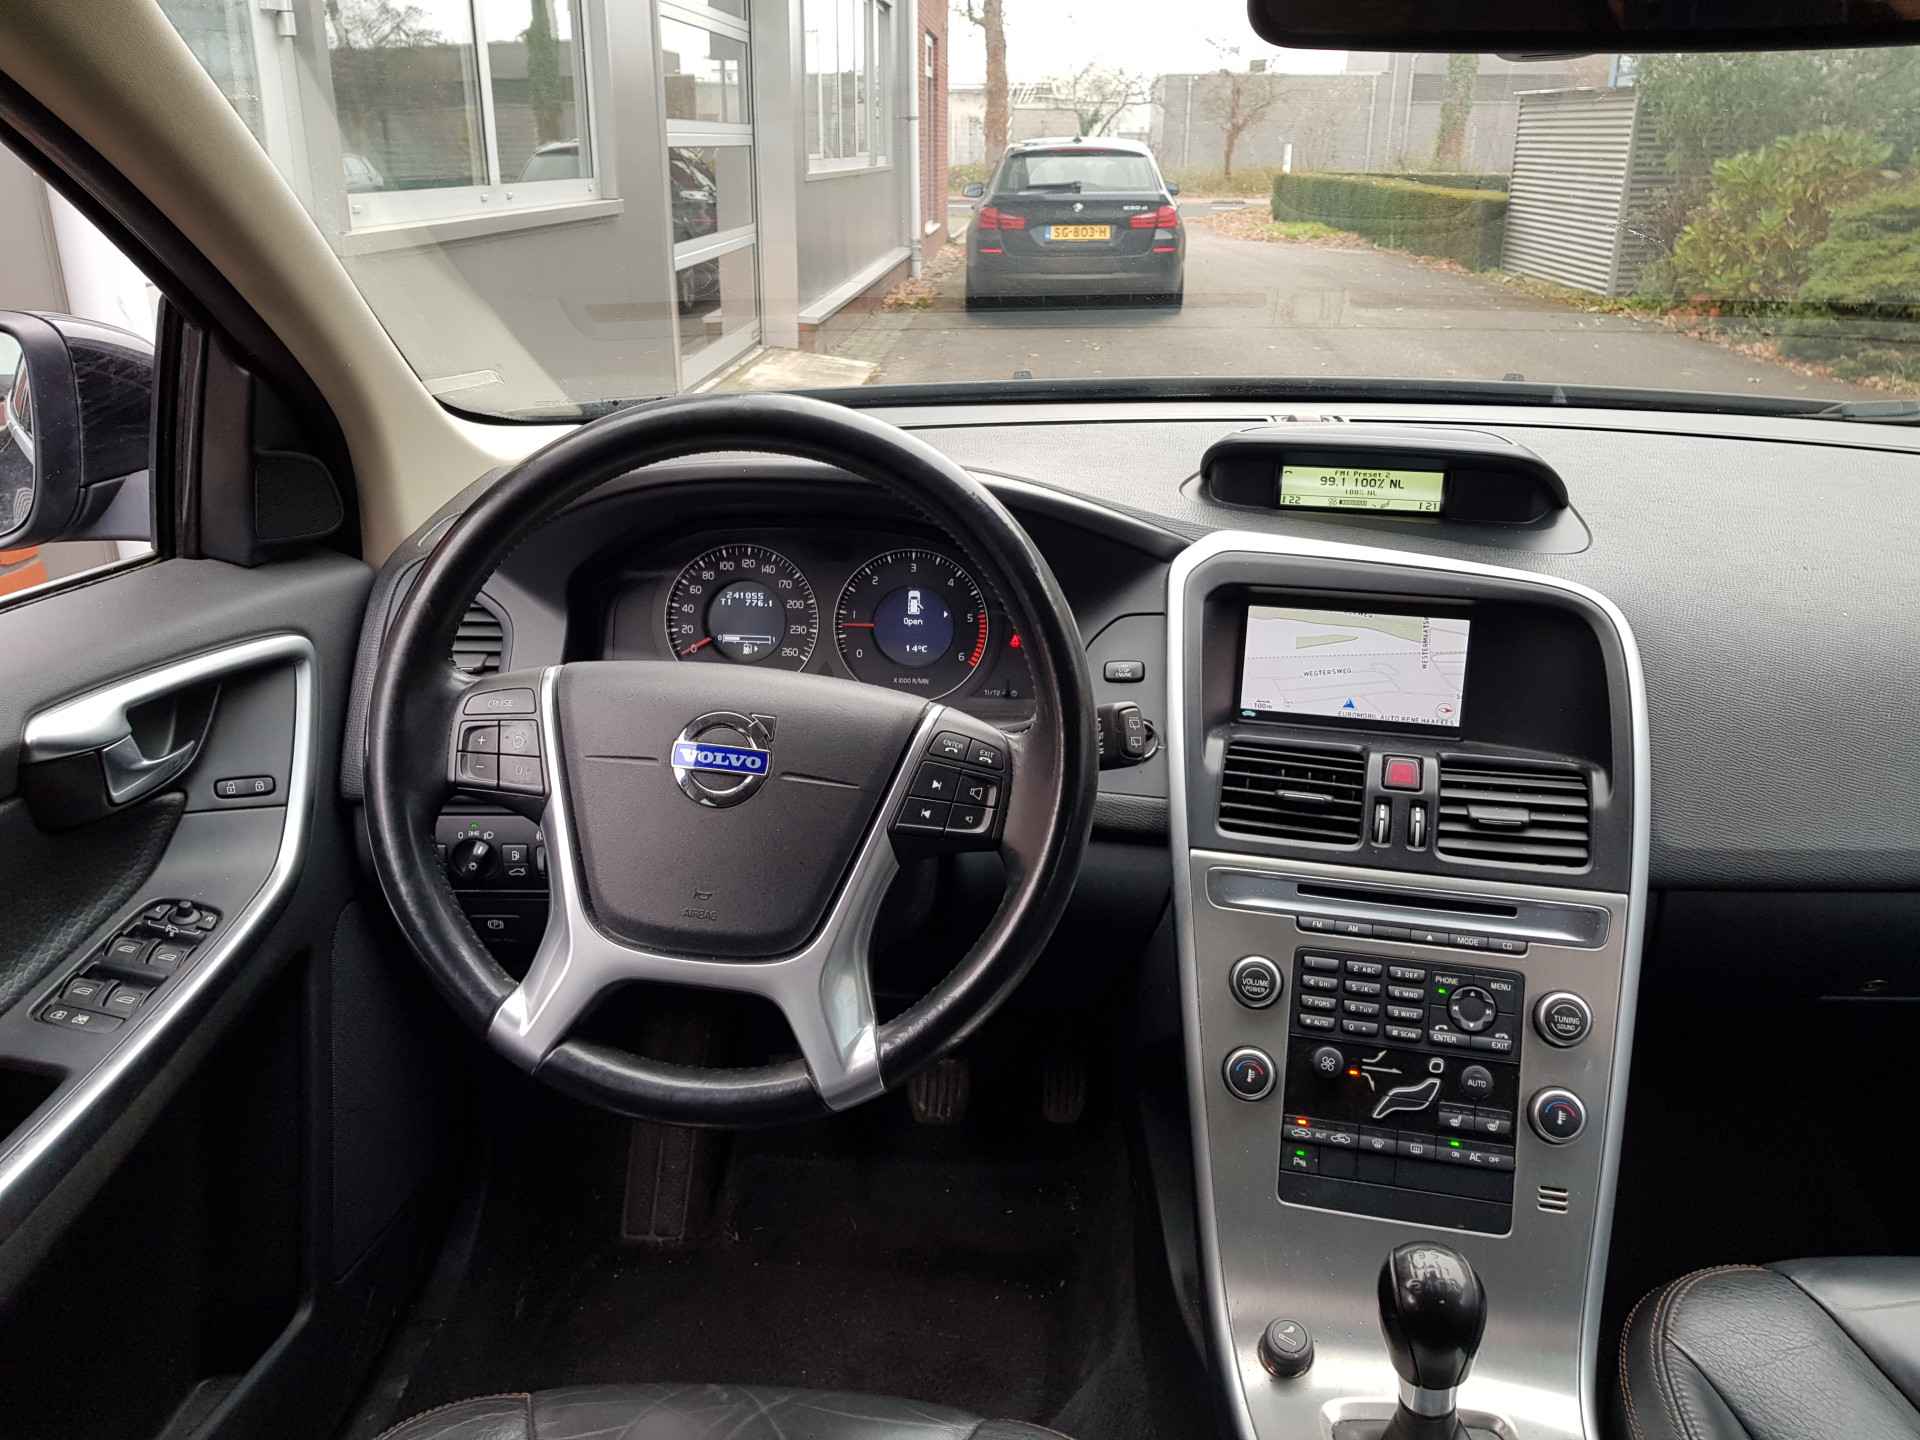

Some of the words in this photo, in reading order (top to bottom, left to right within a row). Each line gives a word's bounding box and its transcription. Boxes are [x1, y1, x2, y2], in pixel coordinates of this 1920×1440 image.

[1053, 226, 1107, 238] SG-803-H
[1353, 470, 1382, 478] Preset
[1320, 476, 1346, 488] 99.1
[1354, 477, 1385, 489] 100%
[1389, 479, 1405, 490] NL
[719, 561, 735, 571] 100
[741, 559, 756, 569] 120
[911, 563, 917, 573] 3
[761, 565, 776, 574] 140
[702, 571, 715, 581] 80
[871, 575, 879, 585] 2
[778, 579, 793, 589] 170
[947, 578, 955, 587] 4
[689, 585, 702, 594] 60
[726, 591, 765, 600] 241055
[745, 599, 773, 608] 776.1
[786, 599, 805, 609] 200
[681, 604, 695, 614] 40
[903, 618, 924, 626] Open
[967, 613, 974, 623] 5
[681, 625, 694, 634] 20
[789, 625, 807, 635] 230
[690, 644, 697, 654] 0
[781, 647, 799, 656] 260
[856, 649, 863, 658] 0
[958, 652, 966, 662] 6
[679, 747, 762, 769] VOLVO
[1312, 920, 1323, 928] FM
[1456, 936, 1479, 946] MODE
[1502, 942, 1513, 950] CD
[1396, 969, 1401, 977] 3
[1242, 977, 1270, 988] VOLUME
[1435, 974, 1459, 985] PHONE
[1244, 984, 1267, 993] POWER
[1490, 981, 1512, 992] MENU
[1307, 998, 1313, 1006] 7
[1393, 1008, 1399, 1017] 9
[1554, 1014, 1580, 1025] TUNING
[1348, 1023, 1355, 1031] 0
[1556, 1022, 1576, 1031] SOUND
[1400, 1030, 1417, 1039] SCAN
[1433, 1033, 1457, 1044] ENTER
[1491, 1041, 1509, 1050] EXIT
[1467, 1079, 1487, 1089] AUTO
[1469, 1152, 1481, 1162] AC
